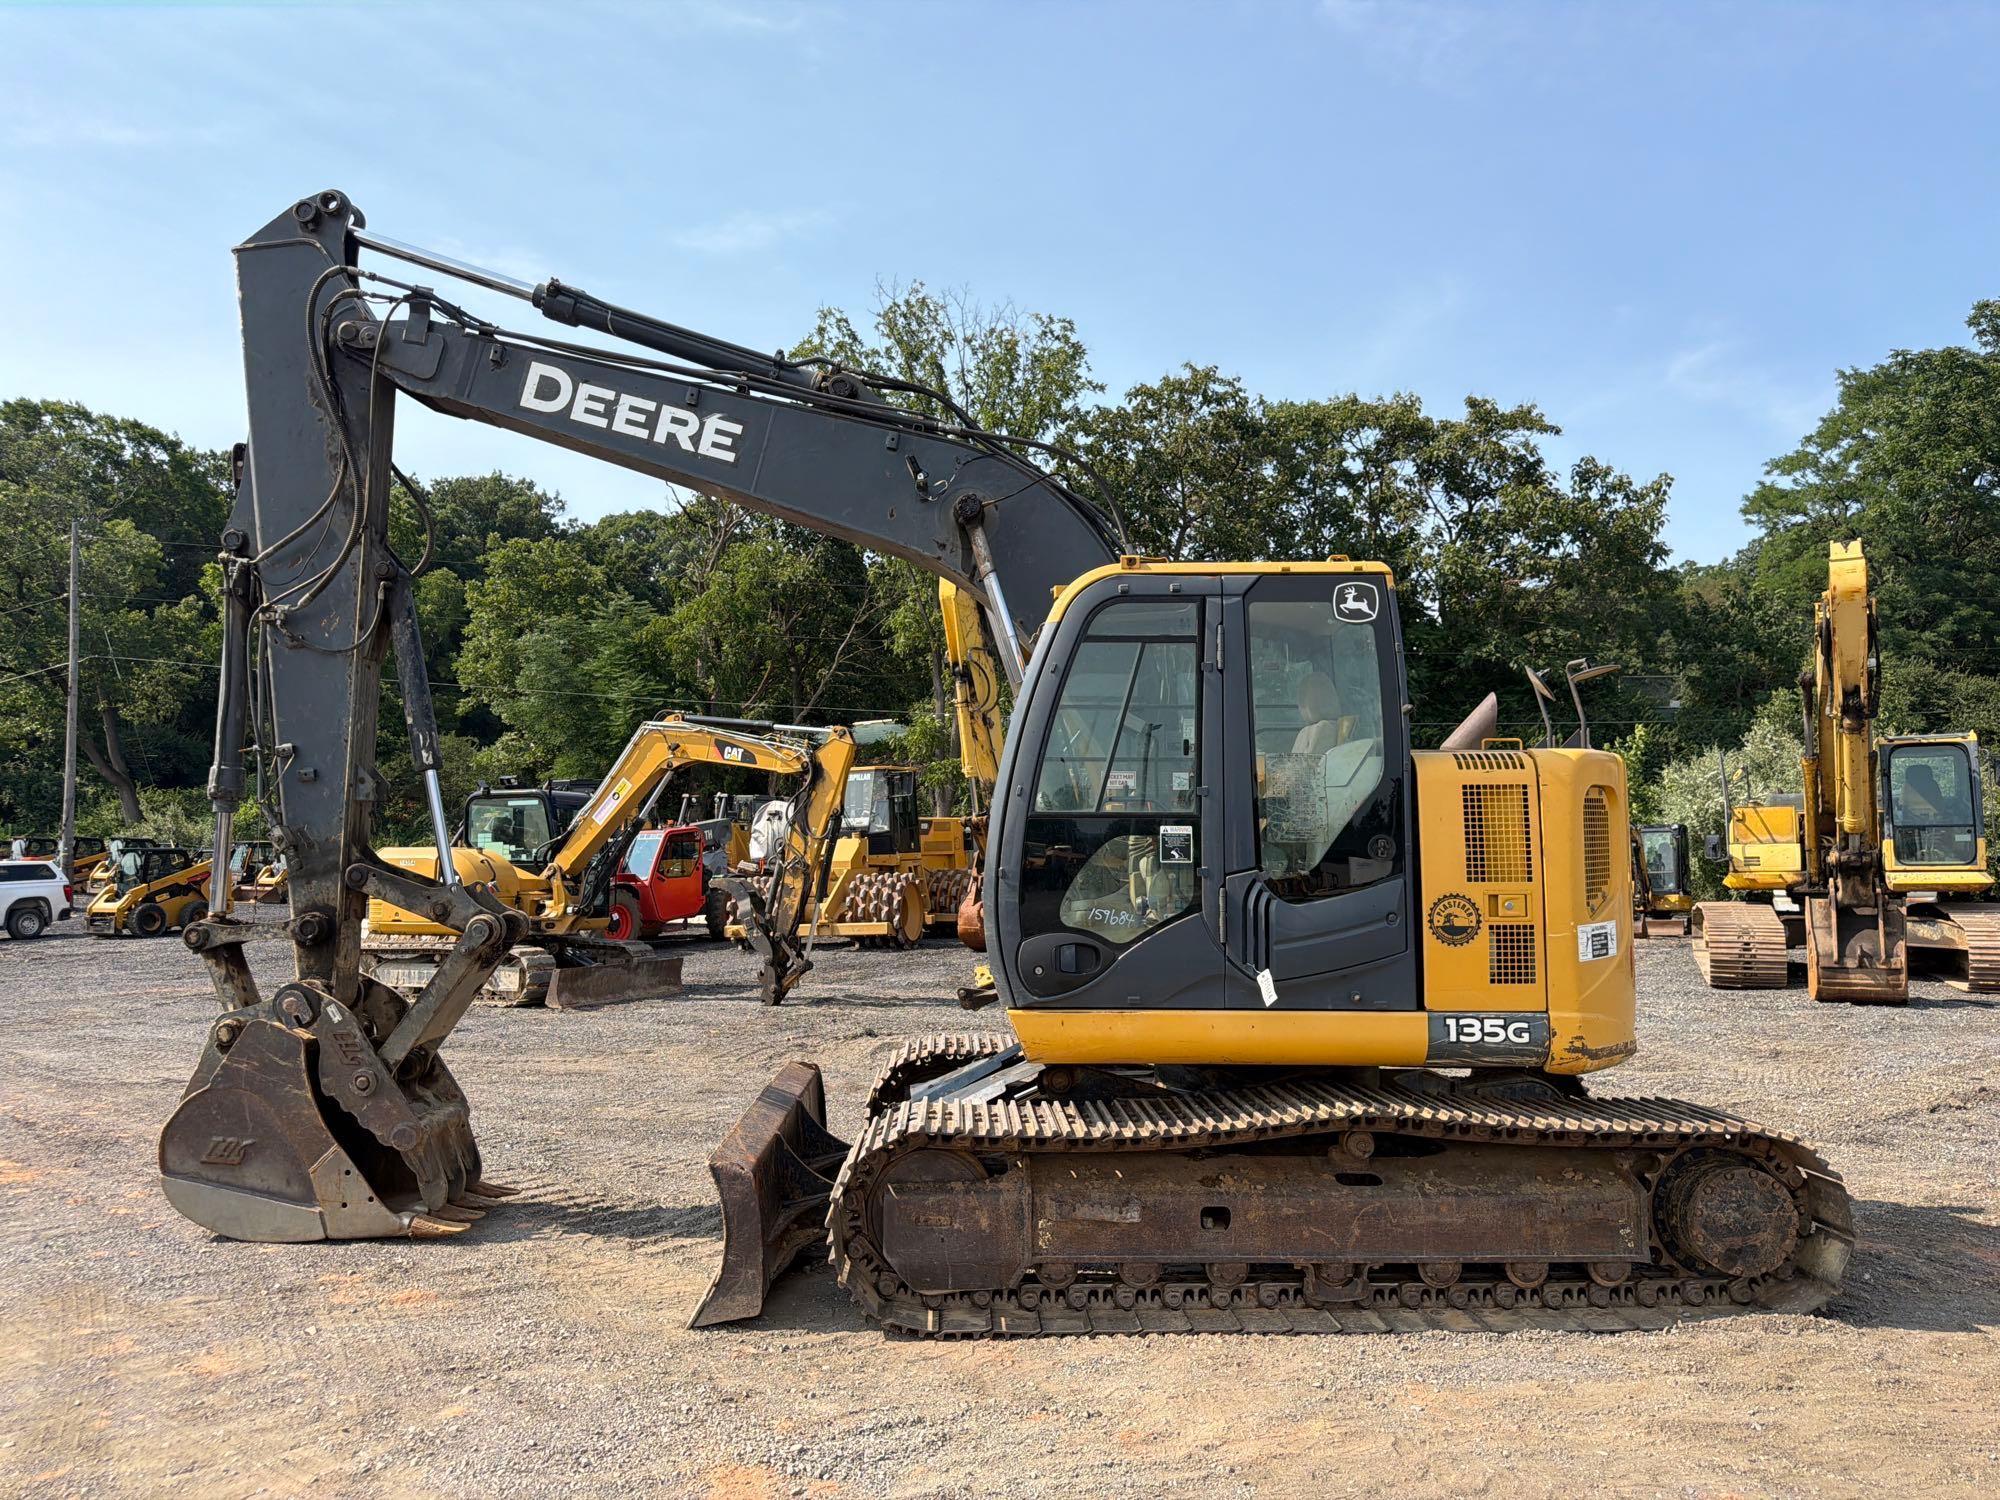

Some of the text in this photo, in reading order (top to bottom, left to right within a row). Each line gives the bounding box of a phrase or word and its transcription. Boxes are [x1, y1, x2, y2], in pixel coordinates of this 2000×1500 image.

[520, 361, 743, 462] DEERE
[724, 746, 744, 761] CAT
[1088, 908, 1135, 928] 159684
[1436, 901, 1473, 917] PLASTERER
[1446, 1018, 1530, 1043] 135G
